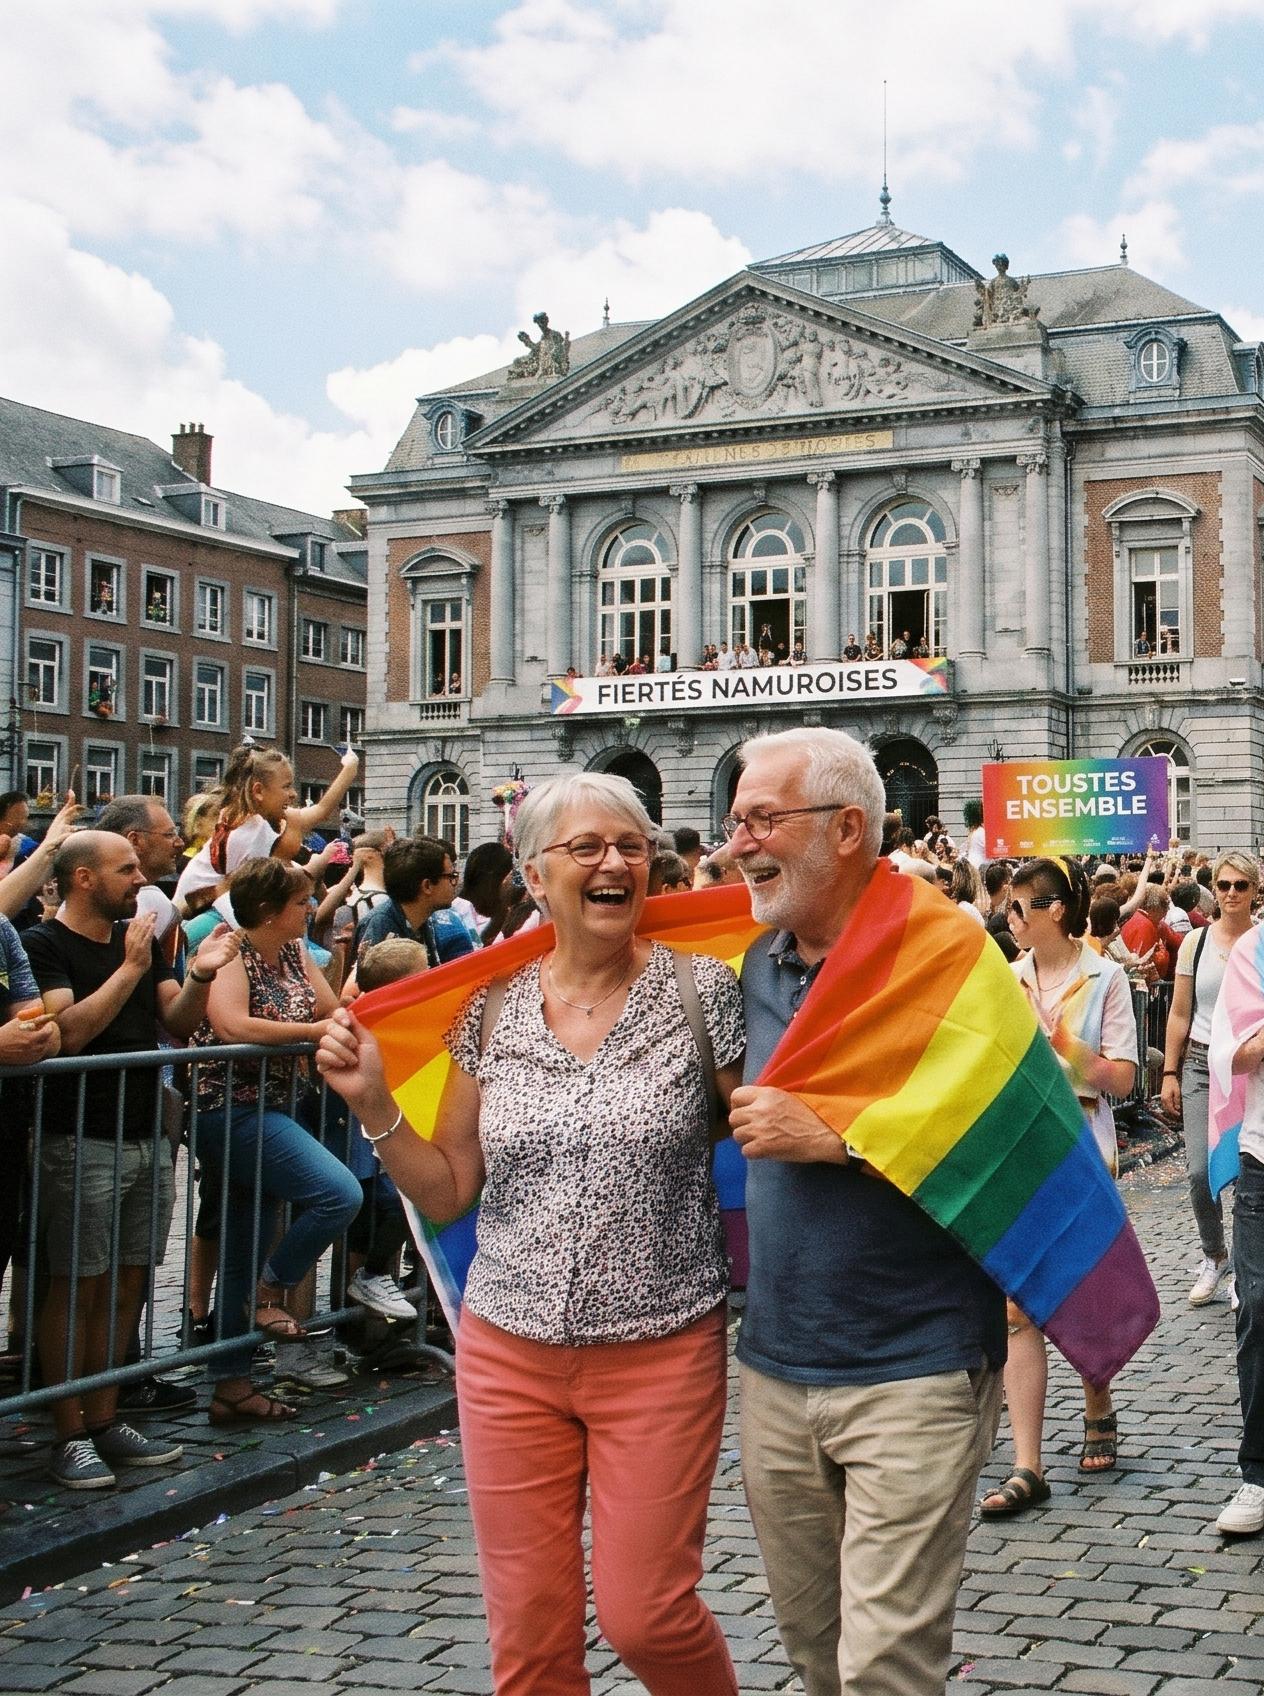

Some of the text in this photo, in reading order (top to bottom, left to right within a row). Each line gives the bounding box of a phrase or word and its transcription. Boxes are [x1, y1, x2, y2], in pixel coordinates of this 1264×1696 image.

[598, 668, 898, 705] FIERTÉS NAMUROISES
[1016, 771, 1136, 795] TOUSTES
[1006, 795, 1147, 820] ENSEMBLE
